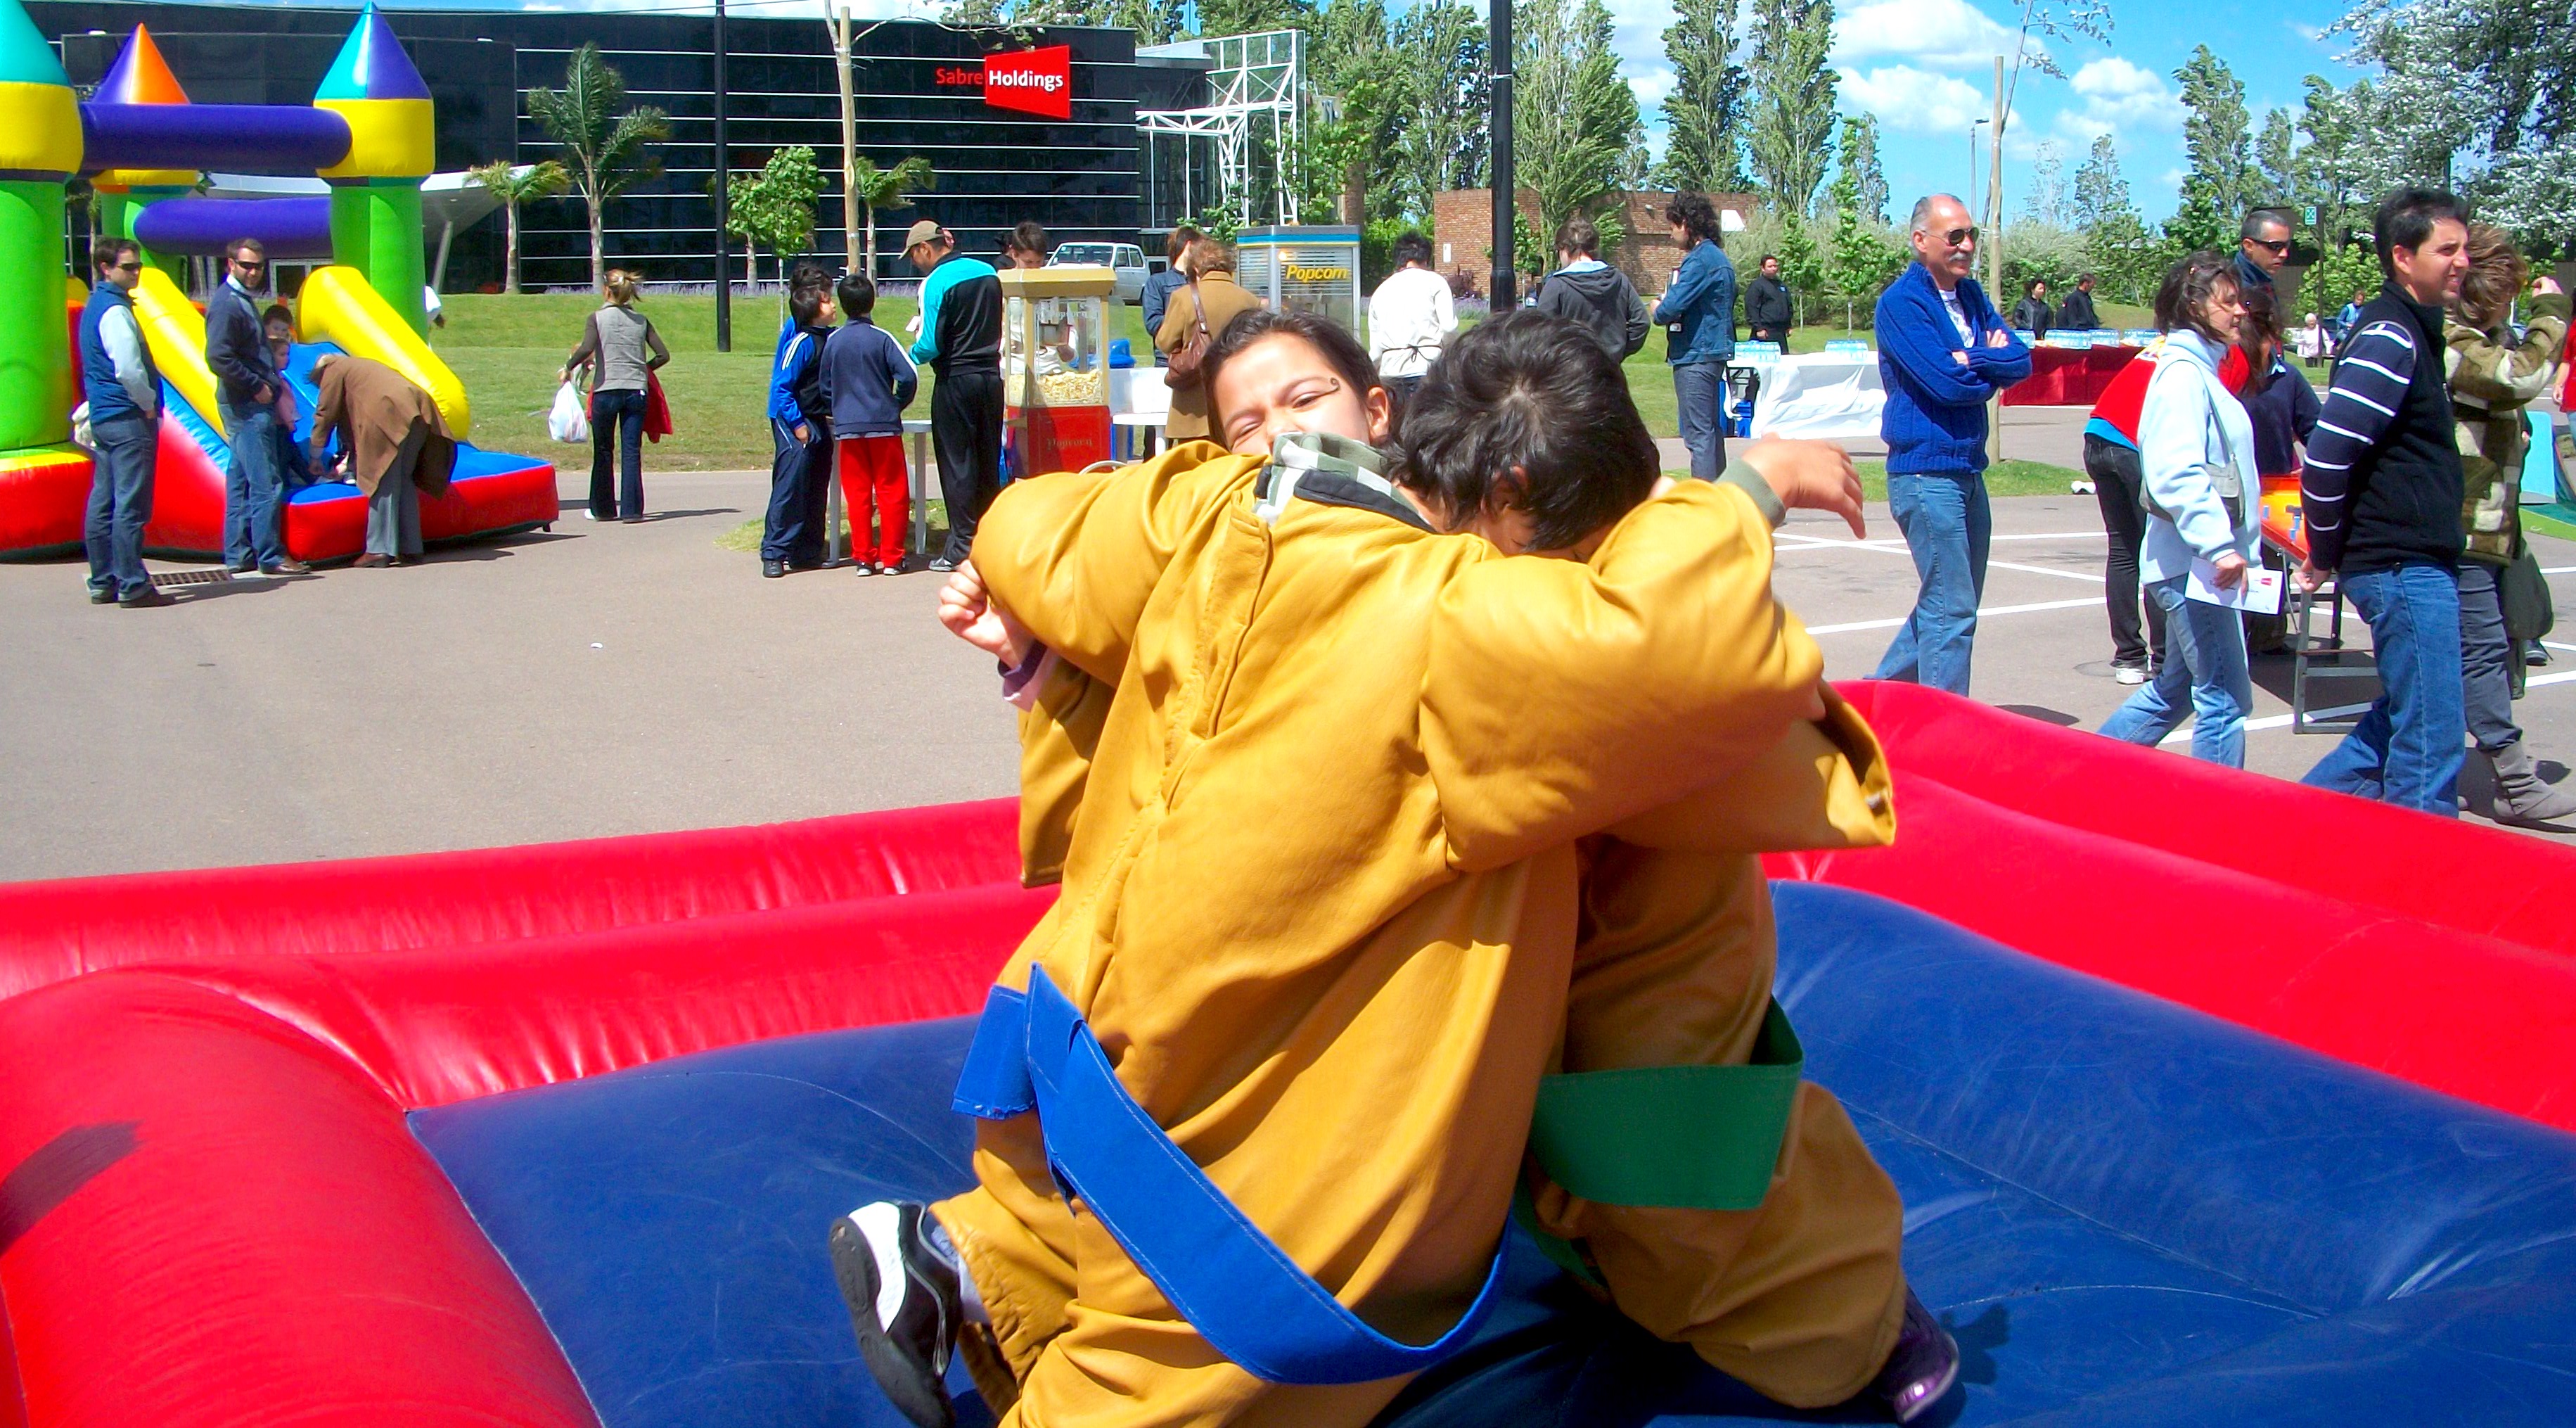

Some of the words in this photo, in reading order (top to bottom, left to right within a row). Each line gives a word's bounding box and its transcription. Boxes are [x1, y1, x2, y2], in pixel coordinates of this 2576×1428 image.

[935, 68, 983, 84] Sabre
[988, 70, 1064, 92] Holdings
[1286, 264, 1347, 283] Popcorn
